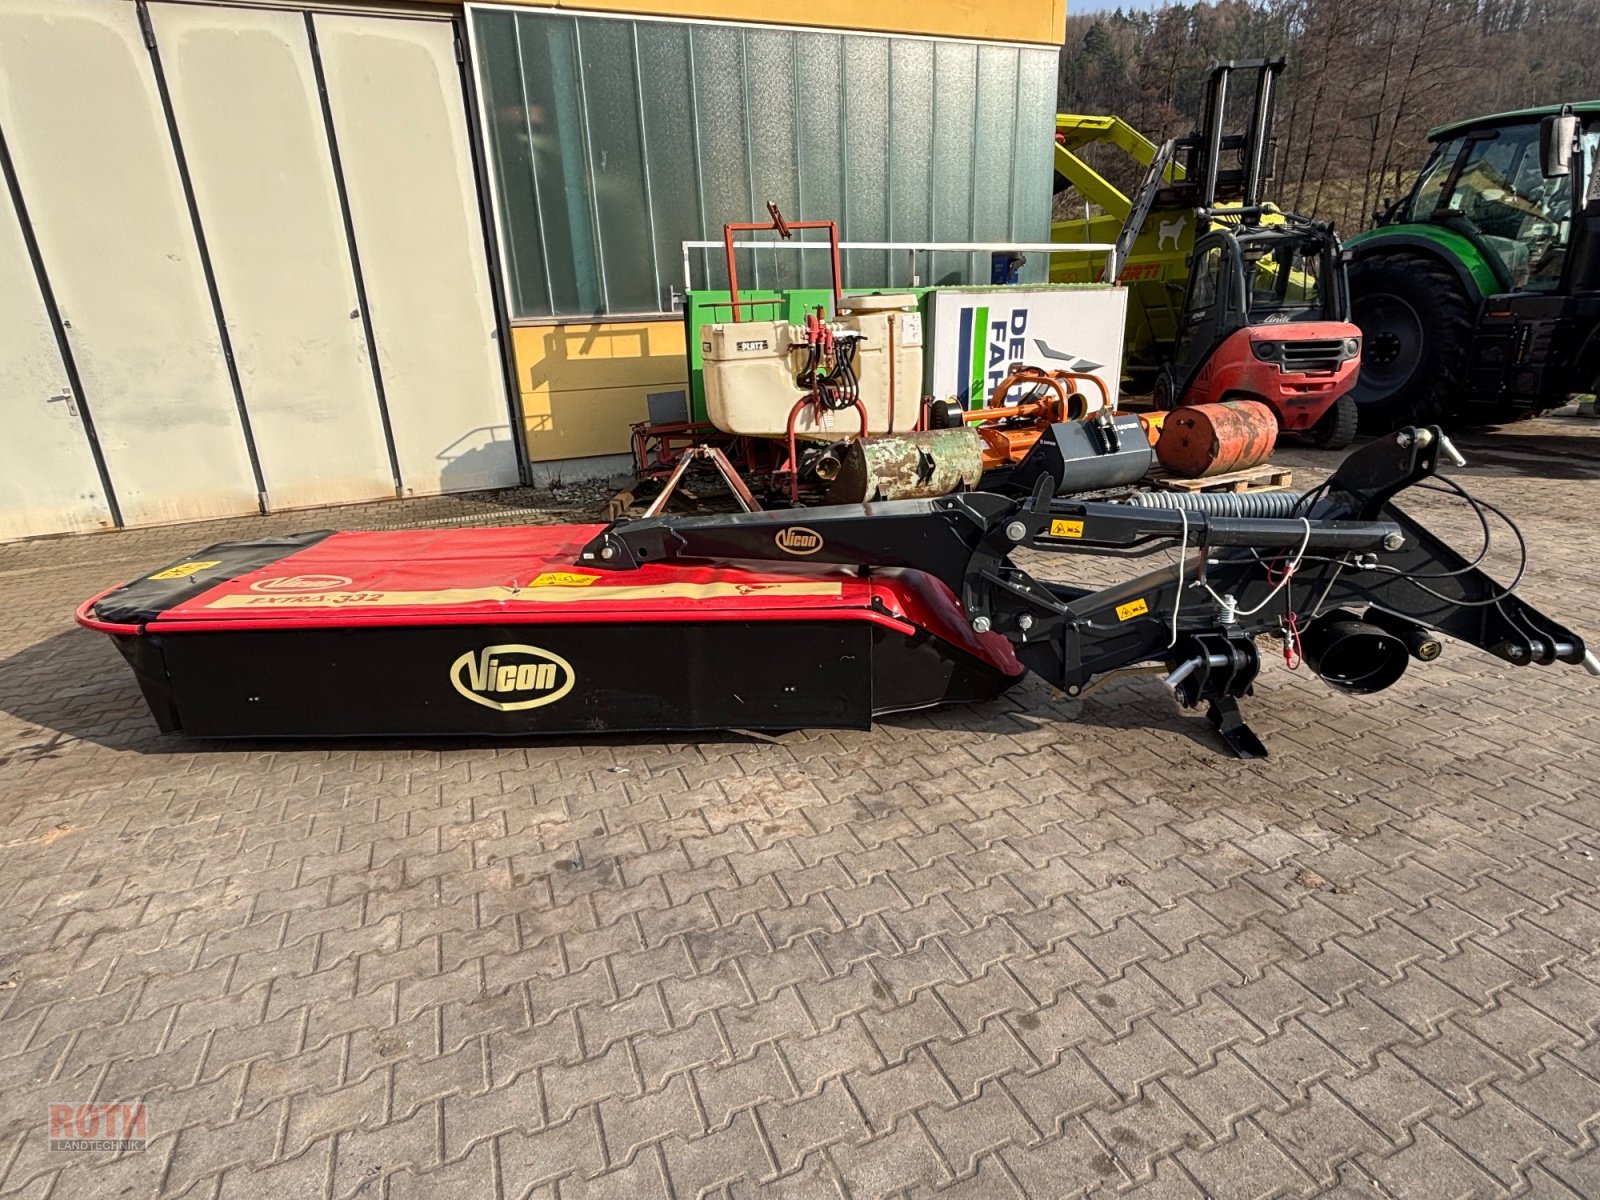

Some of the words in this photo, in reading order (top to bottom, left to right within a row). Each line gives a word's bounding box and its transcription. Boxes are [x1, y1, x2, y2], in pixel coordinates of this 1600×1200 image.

[741, 341, 764, 351] PLATZ
[988, 321, 1007, 405] FAH
[464, 644, 560, 694] Vicon
